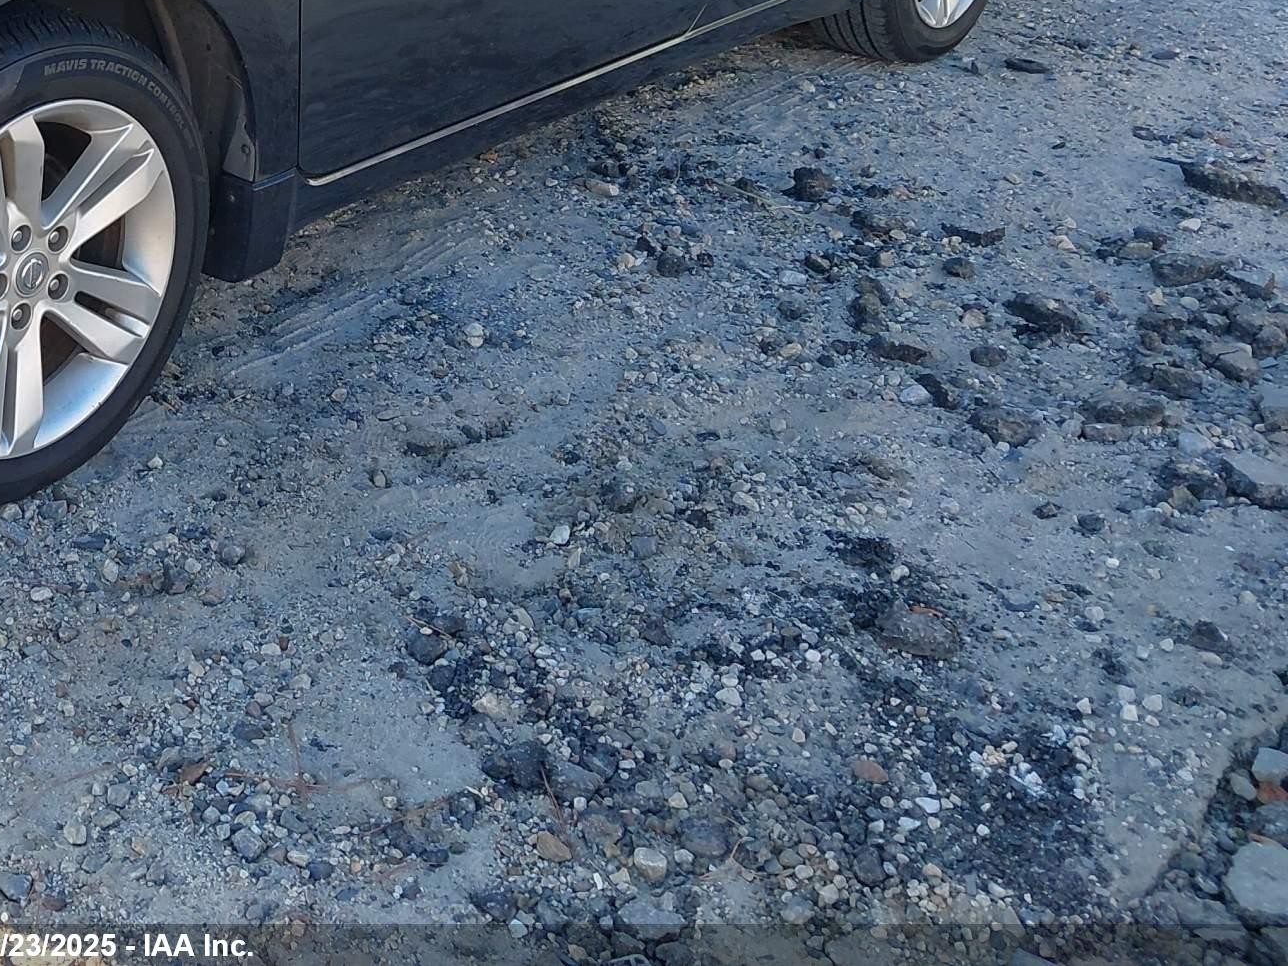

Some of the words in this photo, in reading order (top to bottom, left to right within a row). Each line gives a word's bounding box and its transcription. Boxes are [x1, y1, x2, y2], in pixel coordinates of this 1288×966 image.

[44, 58, 88, 76] MAVIS
[90, 59, 148, 87] TRACTION
[146, 81, 186, 130] CONTROL
